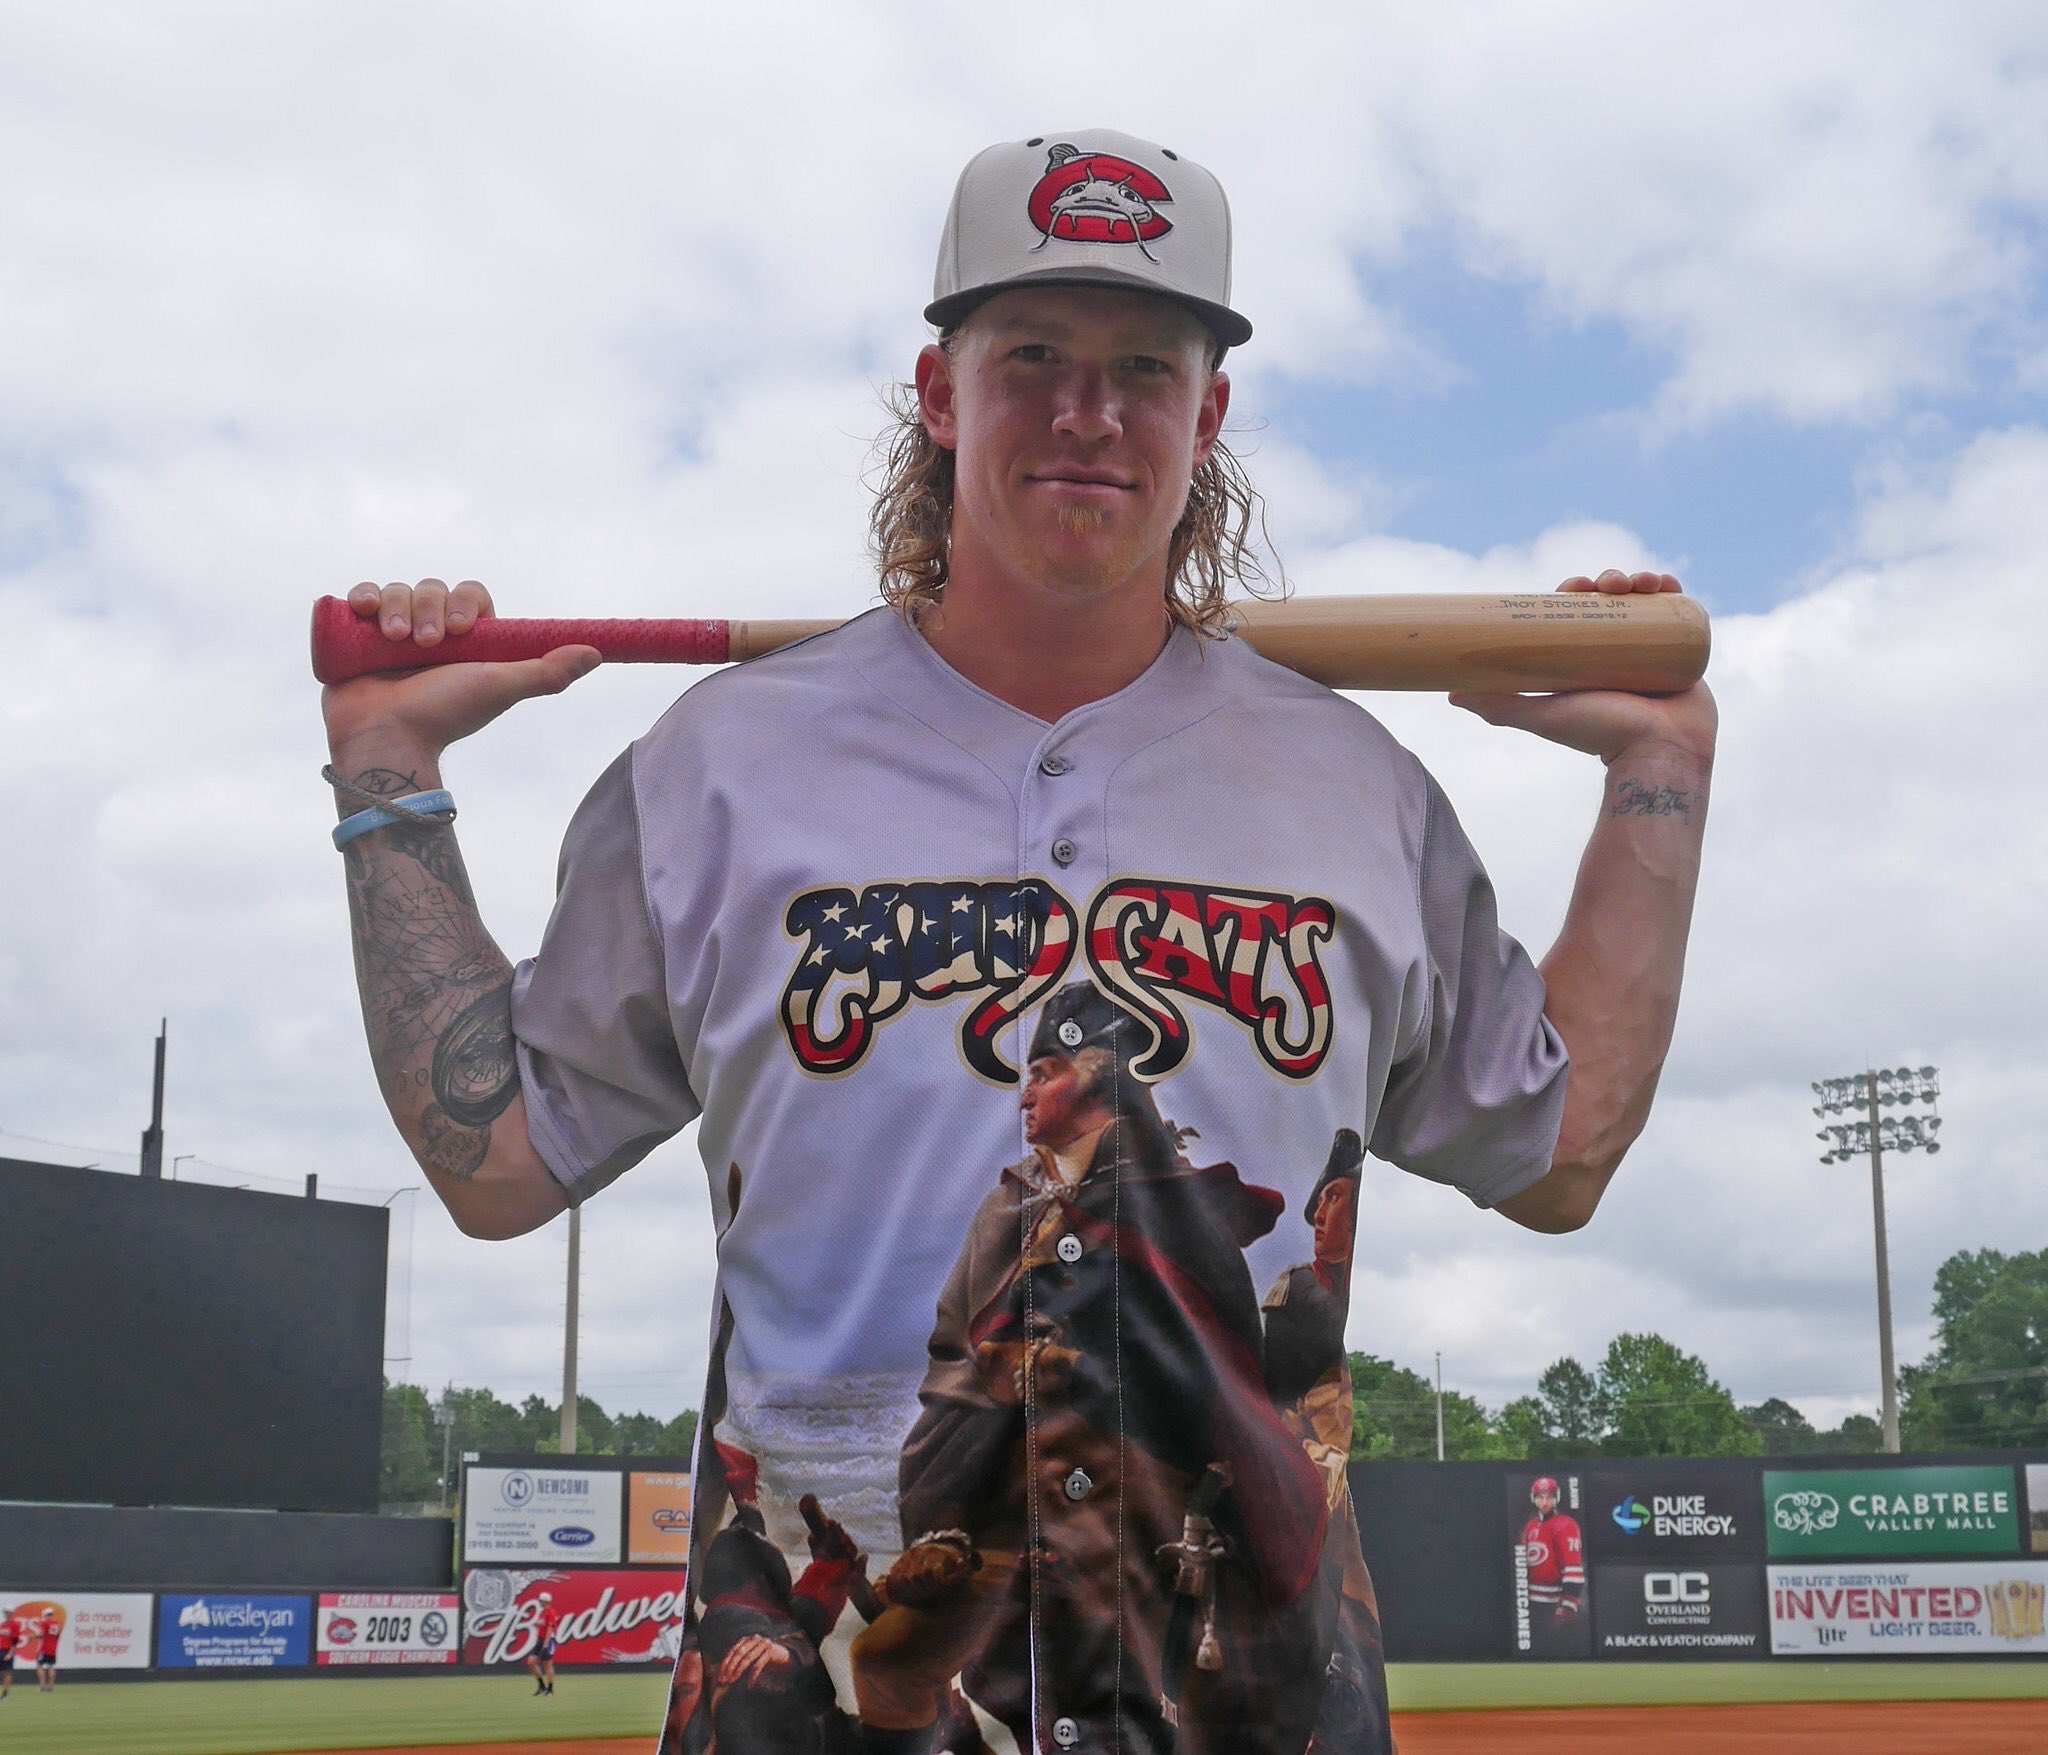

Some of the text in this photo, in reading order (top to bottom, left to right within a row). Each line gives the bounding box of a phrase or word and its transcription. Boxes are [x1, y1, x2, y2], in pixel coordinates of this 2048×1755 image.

[1500, 599, 1631, 608] TROY STOKES JR.
[537, 1478, 589, 1495] NEWCOMB
[1653, 1496, 1706, 1516] DUKE
[1850, 1491, 2009, 1516] CRABTREE
[1865, 1516, 1997, 1532] VALLEY MALL
[554, 1530, 591, 1543] Carrier
[1644, 1572, 1710, 1602] OC
[1777, 1575, 1803, 1587] THE
[1838, 1575, 1873, 1586] BEER
[1875, 1574, 1909, 1586] THAT
[337, 1594, 440, 1608] CAROLINA MUDCATS
[1514, 1544, 1531, 1650] HURRICANES
[1775, 1587, 1983, 1620] INVENTED
[75, 1611, 122, 1623] do more
[1646, 1604, 1711, 1616] OVERLAND
[211, 1602, 294, 1637] wesleyan
[74, 1627, 132, 1639] feel better
[365, 1617, 411, 1642] 2003
[1815, 1625, 1847, 1646] Lite
[1870, 1622, 1982, 1637] LIGHT BEER.
[1605, 1634, 1756, 1647] A BLACK & VEATCH COMPANY
[74, 1643, 130, 1657] live longer
[329, 1651, 448, 1664] SOUTHERN LEAGUE CHAMPIONS
